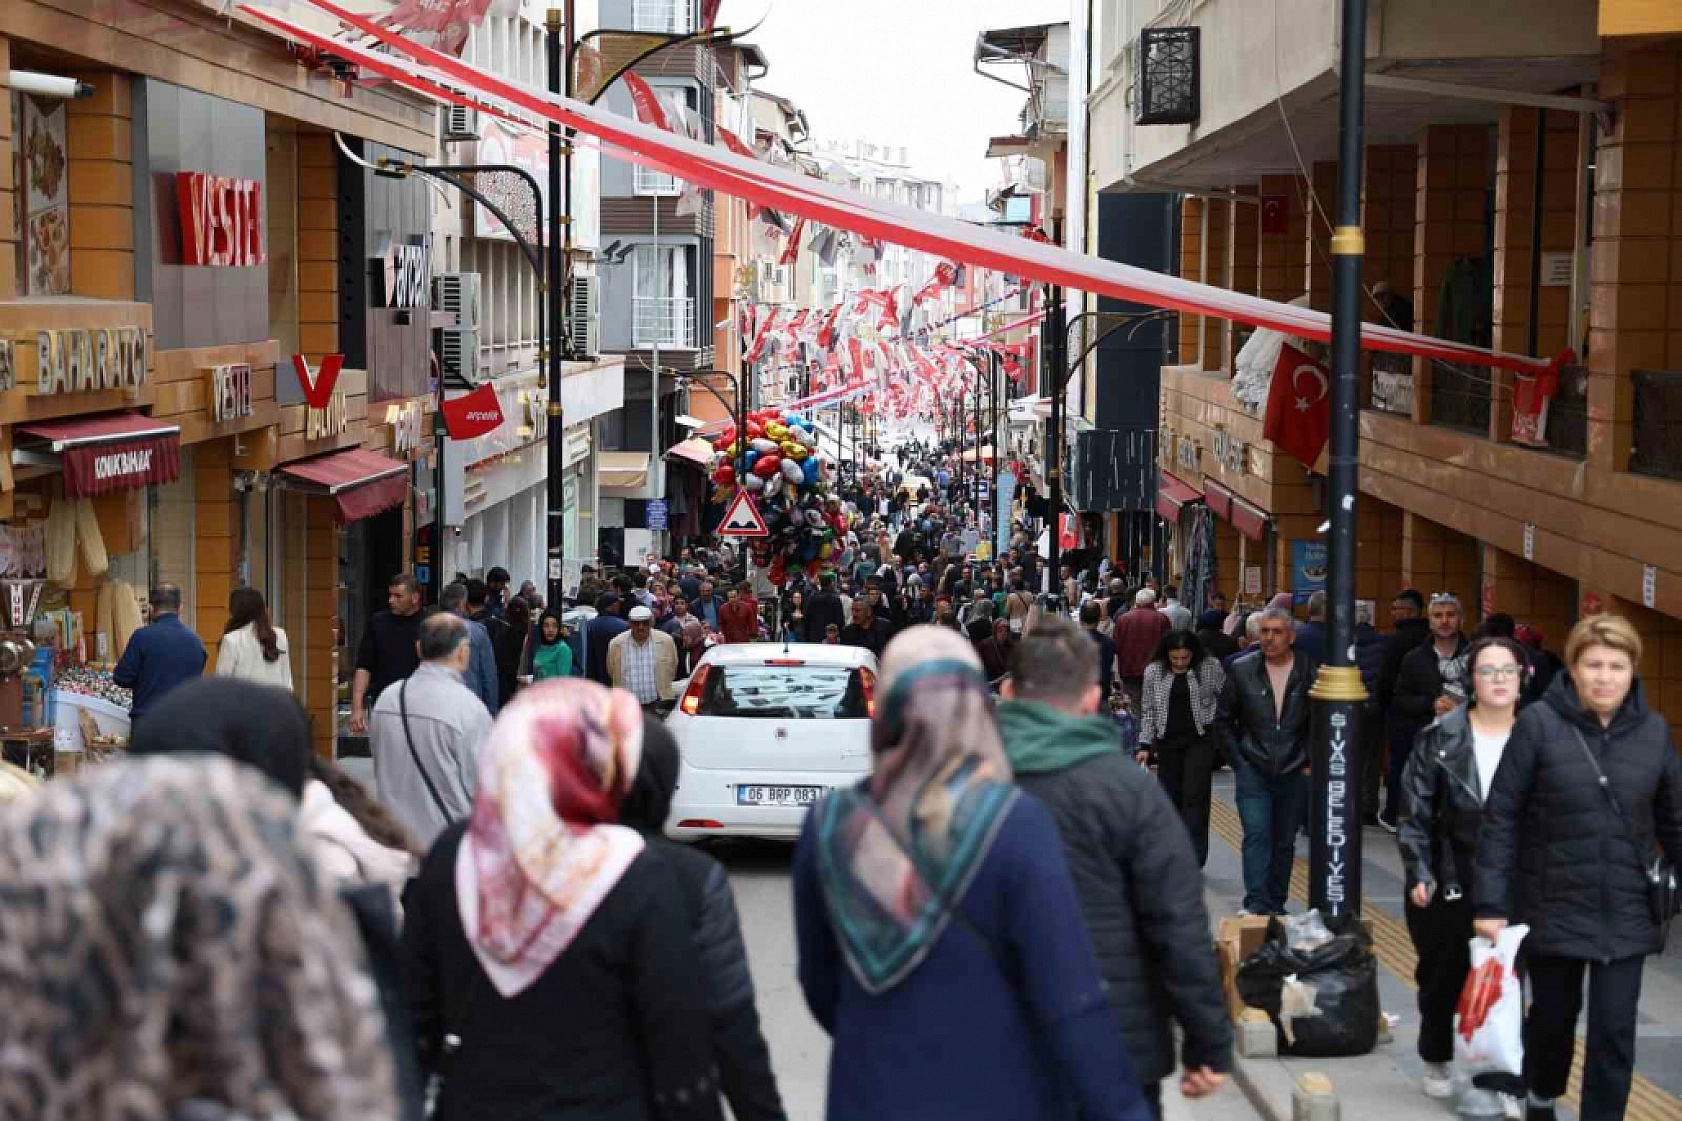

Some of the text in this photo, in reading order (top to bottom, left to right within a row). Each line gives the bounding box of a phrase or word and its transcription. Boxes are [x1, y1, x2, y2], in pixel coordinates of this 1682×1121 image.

[181, 171, 266, 266] VESTEL
[748, 788, 816, 801] 06 BRP 083
